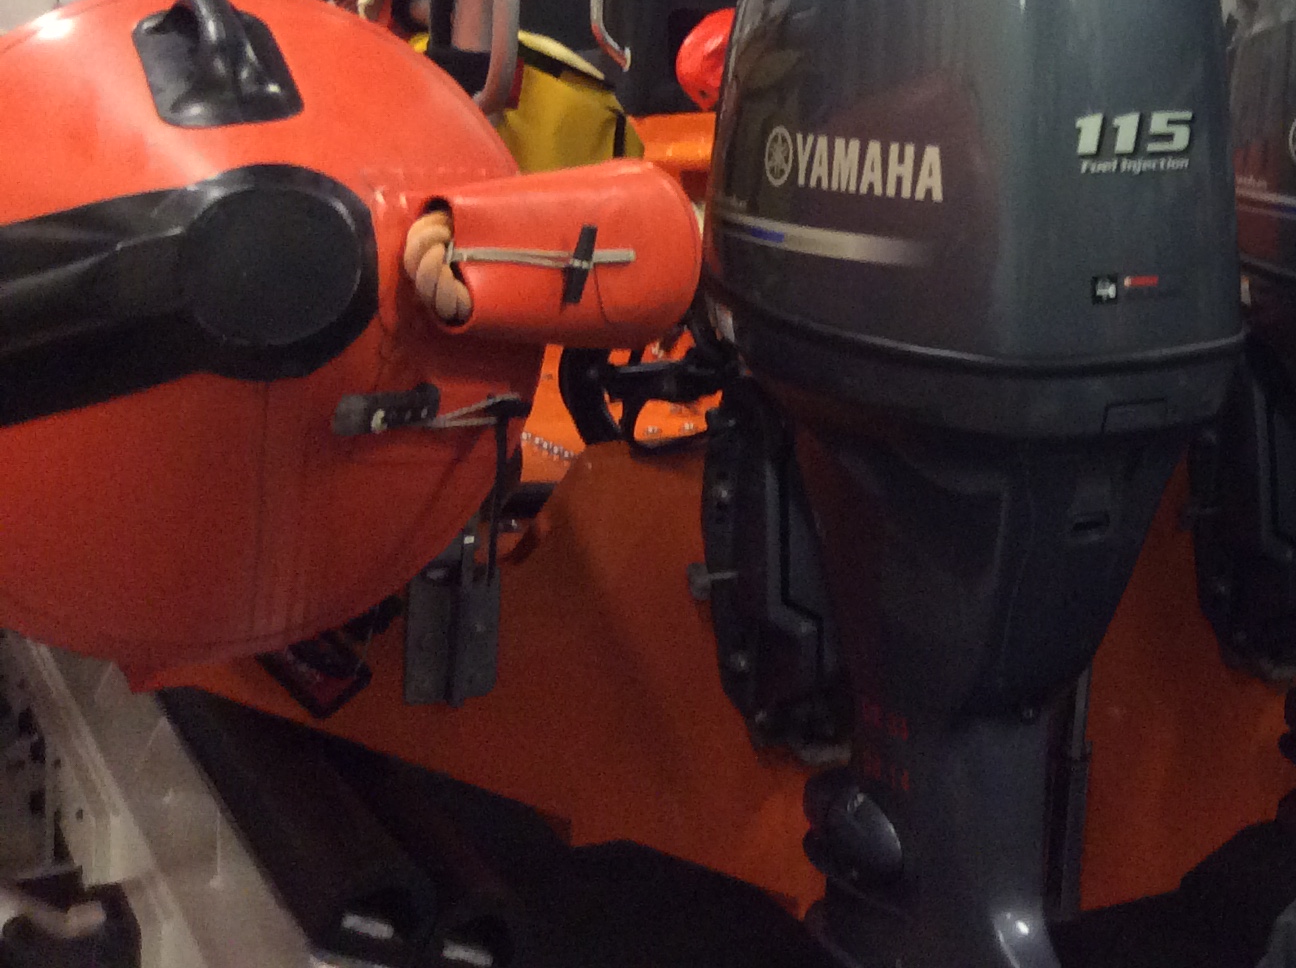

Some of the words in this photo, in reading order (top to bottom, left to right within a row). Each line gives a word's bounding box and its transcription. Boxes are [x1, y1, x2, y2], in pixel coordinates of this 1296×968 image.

[1075, 110, 1193, 155] 115
[796, 132, 943, 202] YAMAHA
[1080, 157, 1119, 174] Fuel
[1120, 156, 1190, 175] Injection
